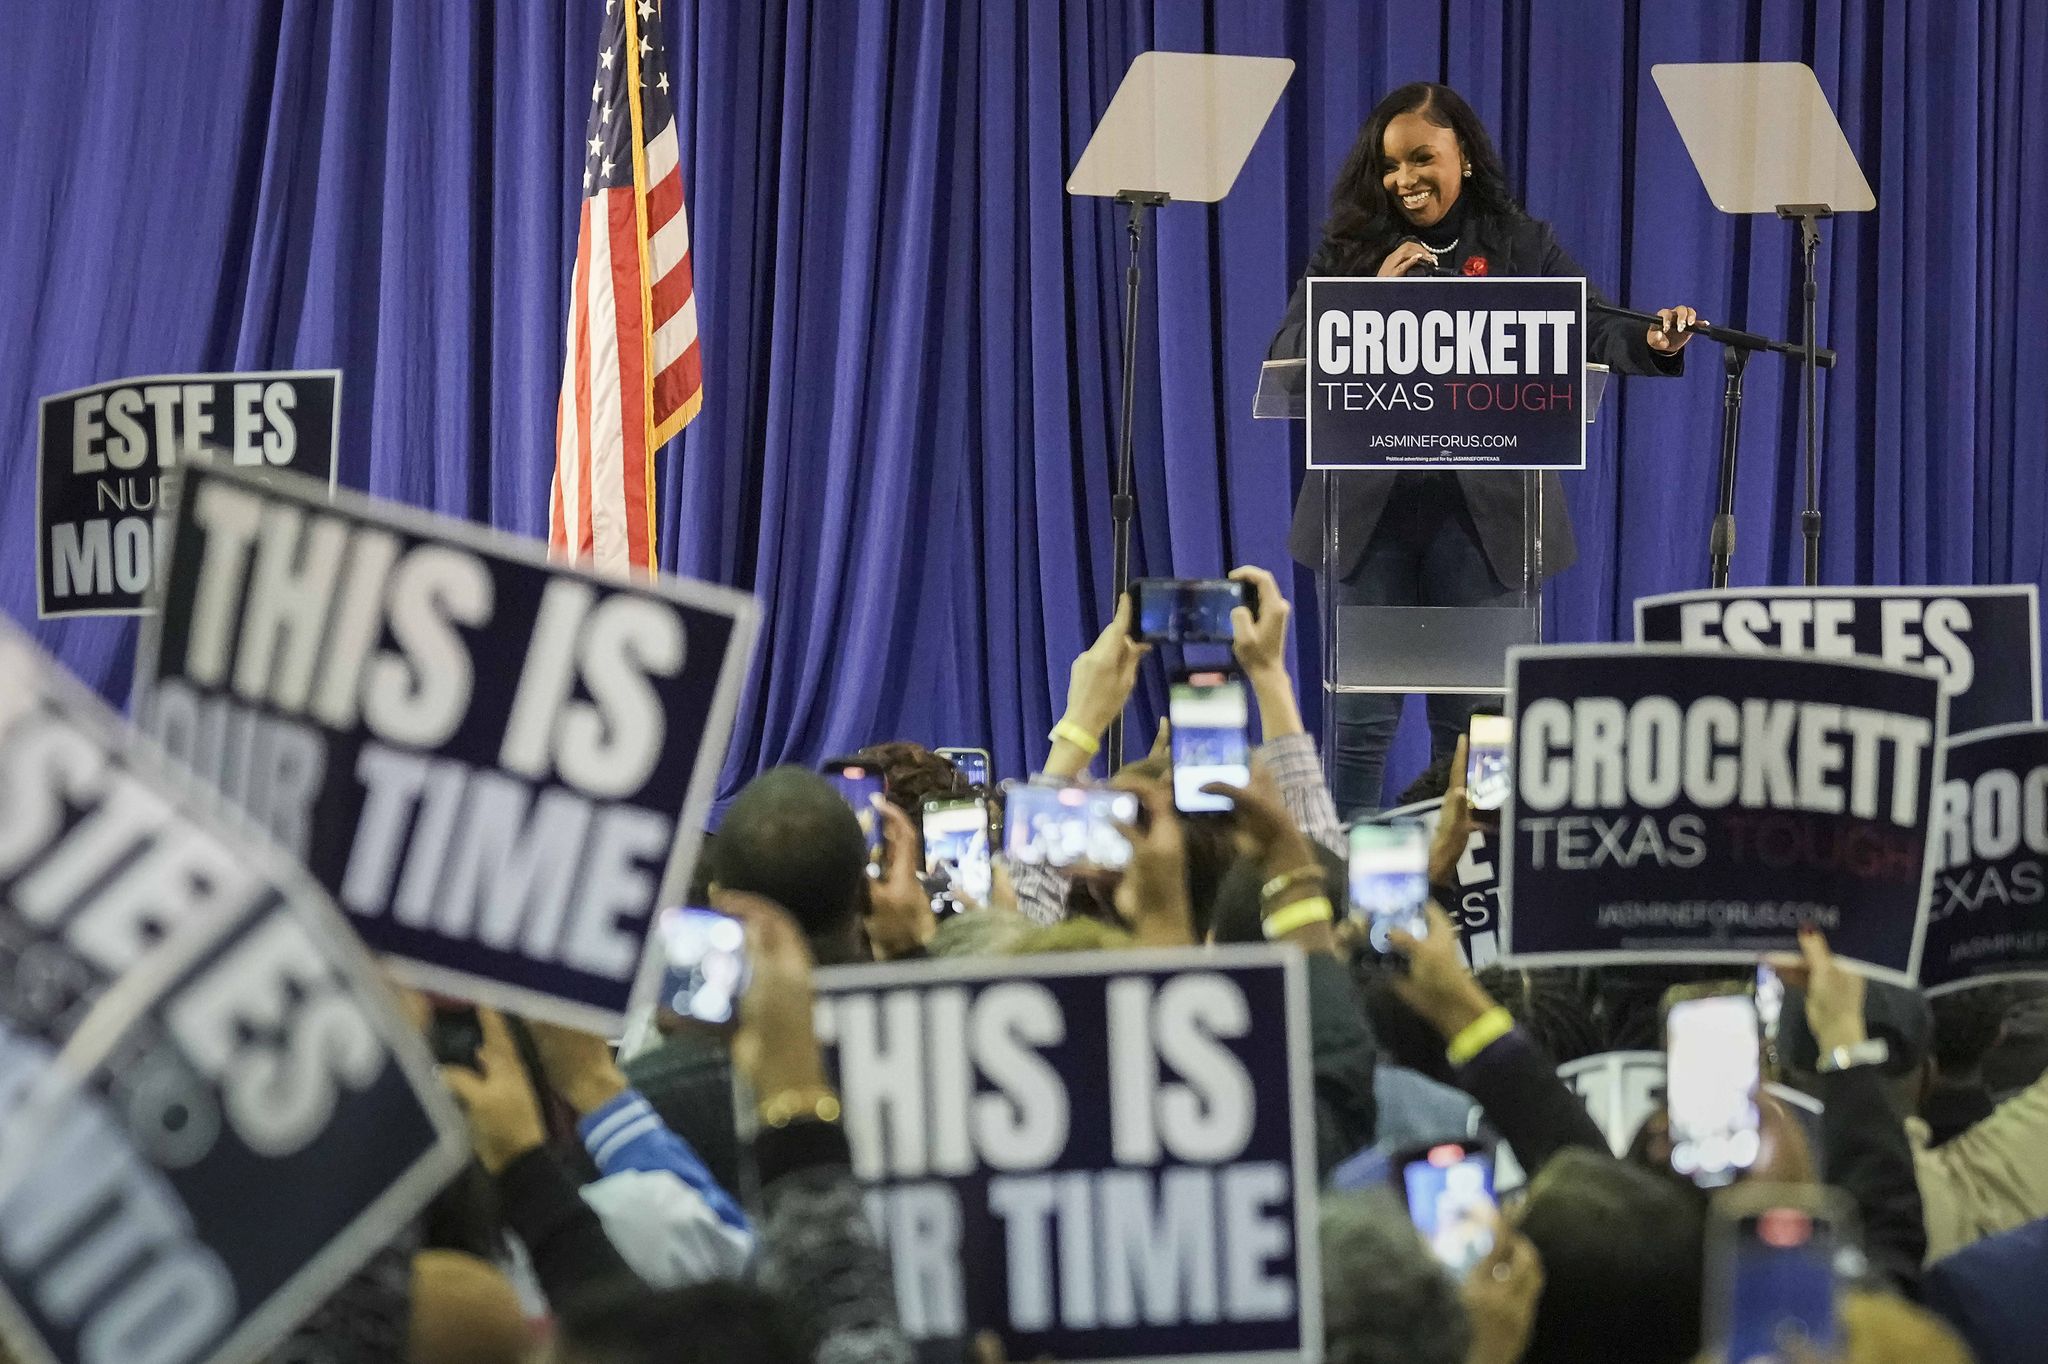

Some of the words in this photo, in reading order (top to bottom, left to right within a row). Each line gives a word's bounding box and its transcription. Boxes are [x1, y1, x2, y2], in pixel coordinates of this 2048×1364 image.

[1318, 309, 1576, 375] CROCKETT
[73, 383, 215, 474] ESTE
[233, 380, 298, 467] ES
[1318, 382, 1435, 412] TEXAS
[1444, 383, 1574, 412] TOUGH
[1369, 434, 1518, 449] JASMINEFORUS.COM
[183, 487, 496, 749] THIS
[500, 576, 690, 800] IS
[1880, 598, 1976, 697] ES
[1518, 695, 1934, 828] CROCKETT
[340, 745, 674, 983] TIME
[1519, 814, 1708, 870] TEXAS
[1930, 866, 2046, 924] EXAS
[1106, 971, 1257, 1167] IS
[987, 1160, 1299, 1333] TIME
